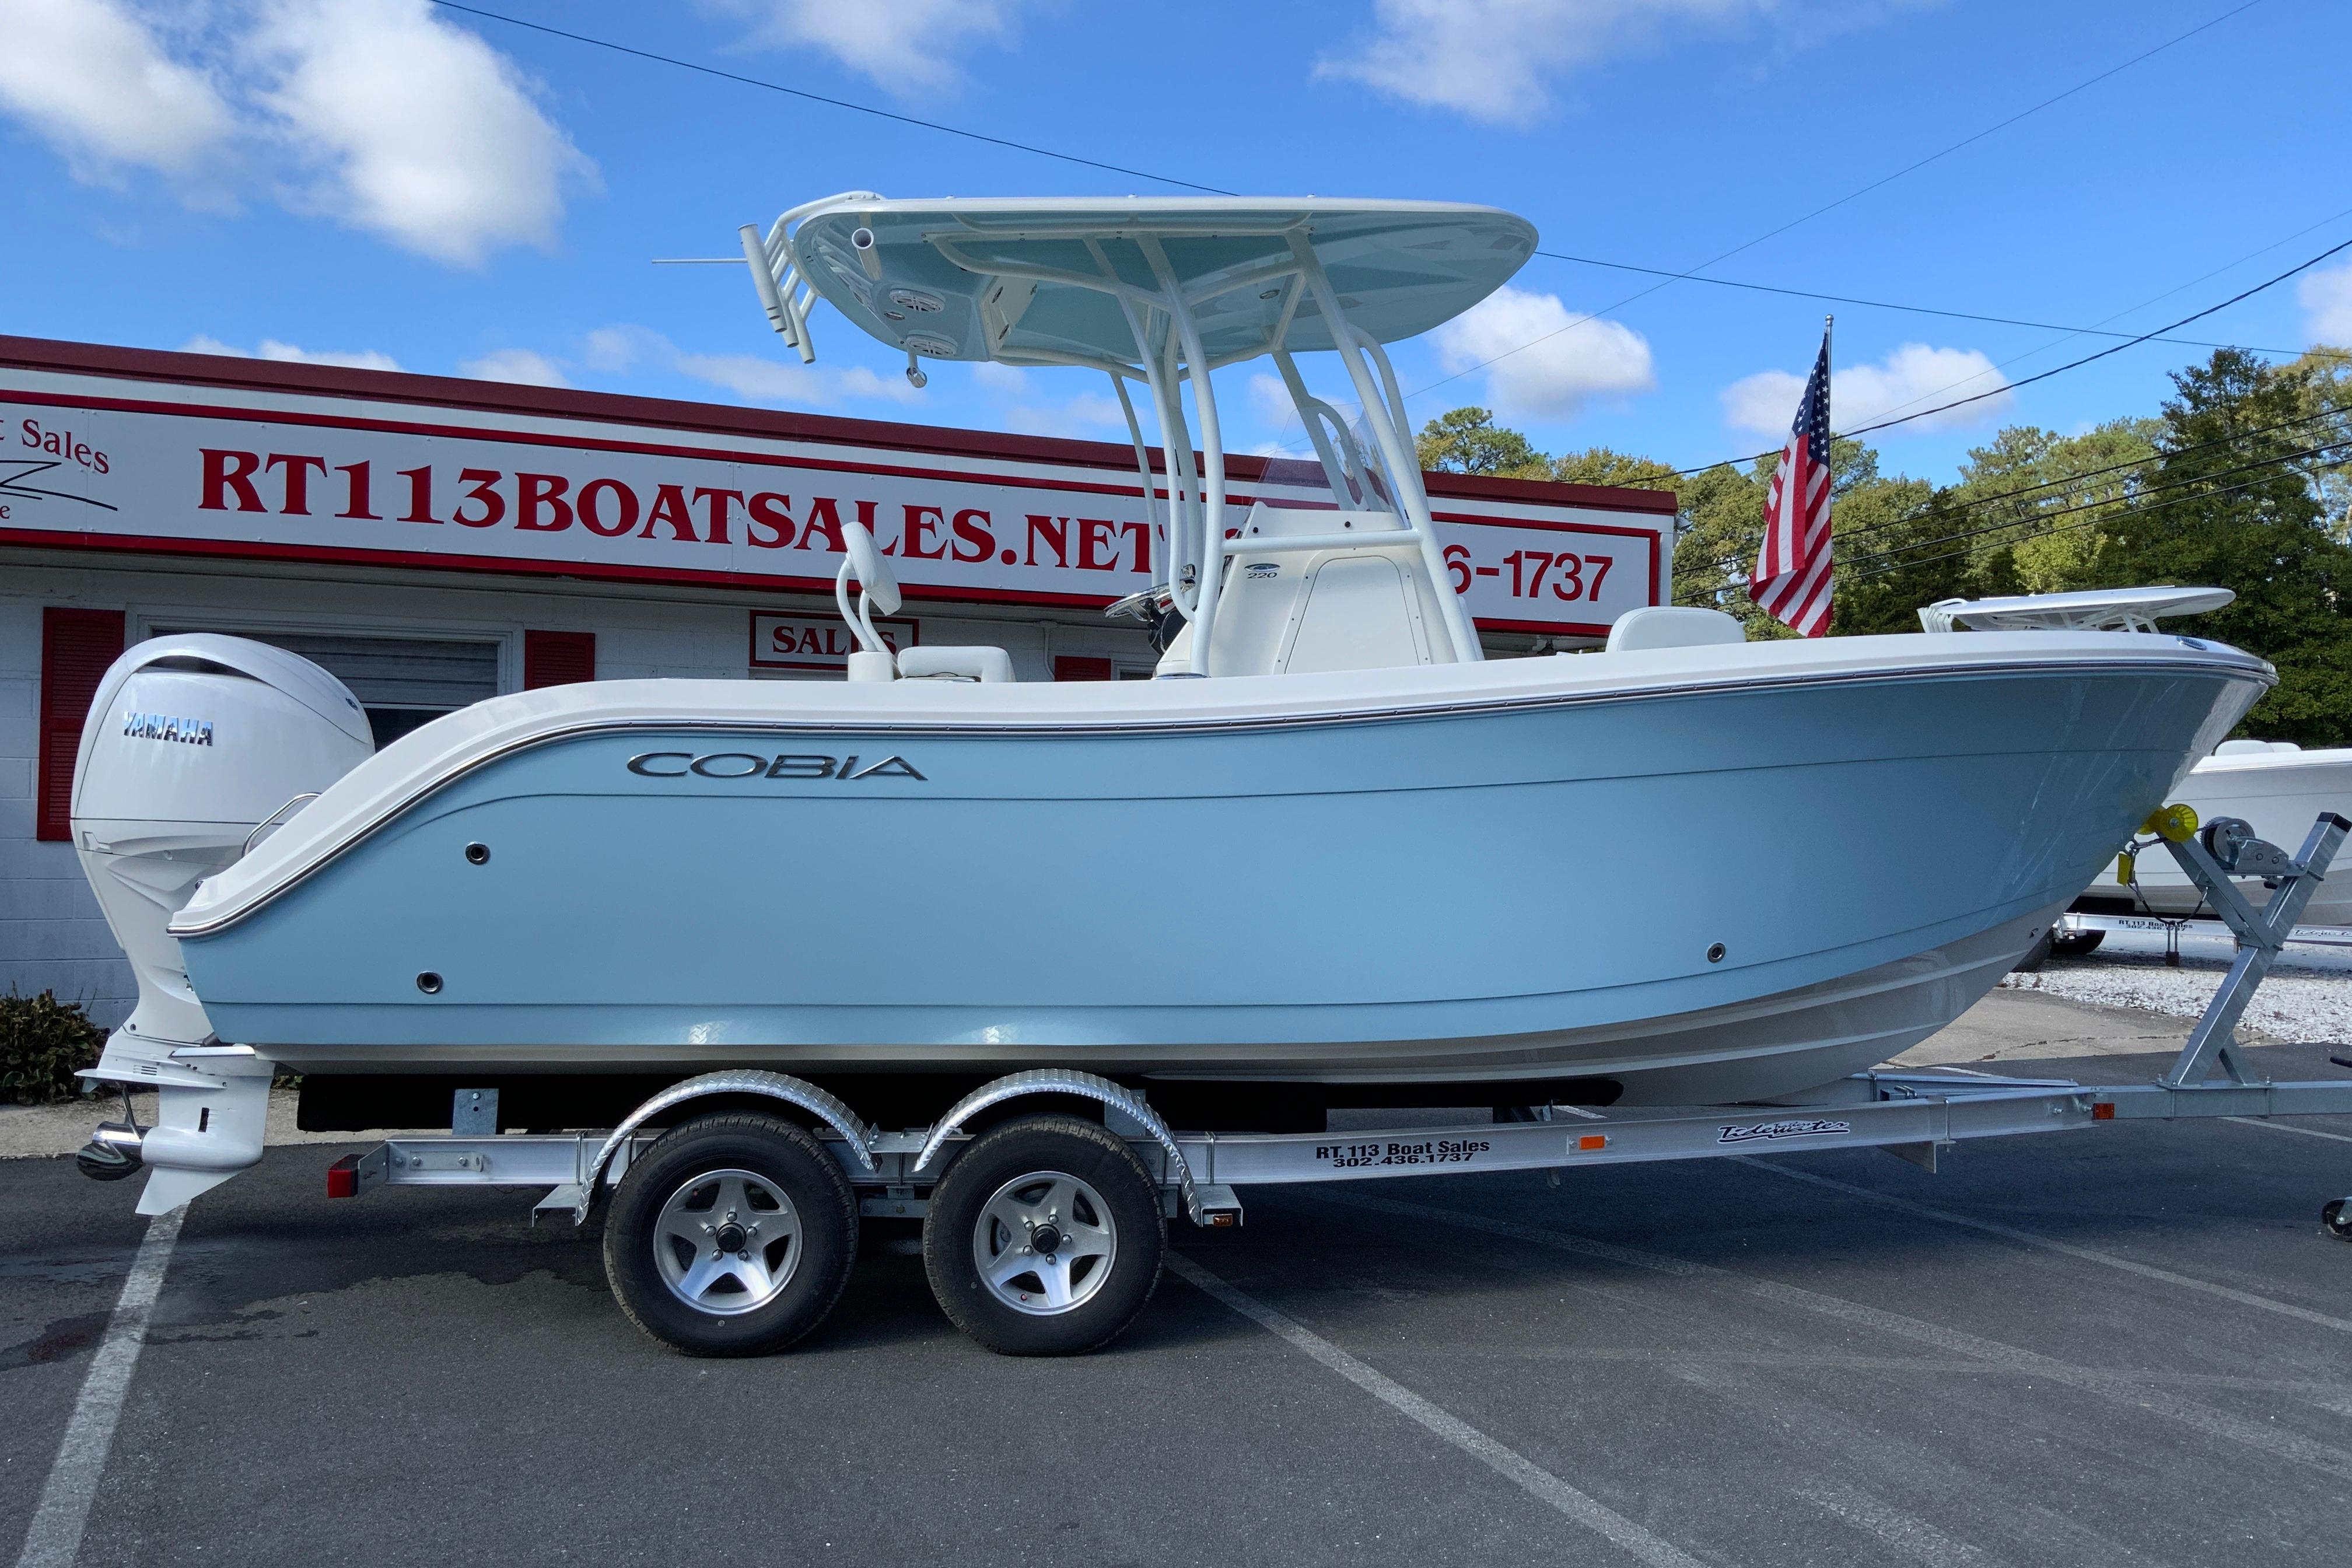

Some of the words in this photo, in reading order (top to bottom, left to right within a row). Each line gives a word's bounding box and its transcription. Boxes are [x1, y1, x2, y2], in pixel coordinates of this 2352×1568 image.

[21, 419, 110, 474] Sales
[198, 448, 1165, 573] RT113BOATSALES.NET
[123, 711, 214, 747] YAMAHA
[626, 752, 929, 780] COBIA
[1719, 1120, 1849, 1140] Tidewater
[1316, 1146, 1344, 1159] RT.
[1347, 1144, 1380, 1157] 113
[1387, 1142, 1433, 1156] Boat
[1438, 1140, 1490, 1153] Sales
[1333, 1152, 1475, 1168] 302.436.1737
